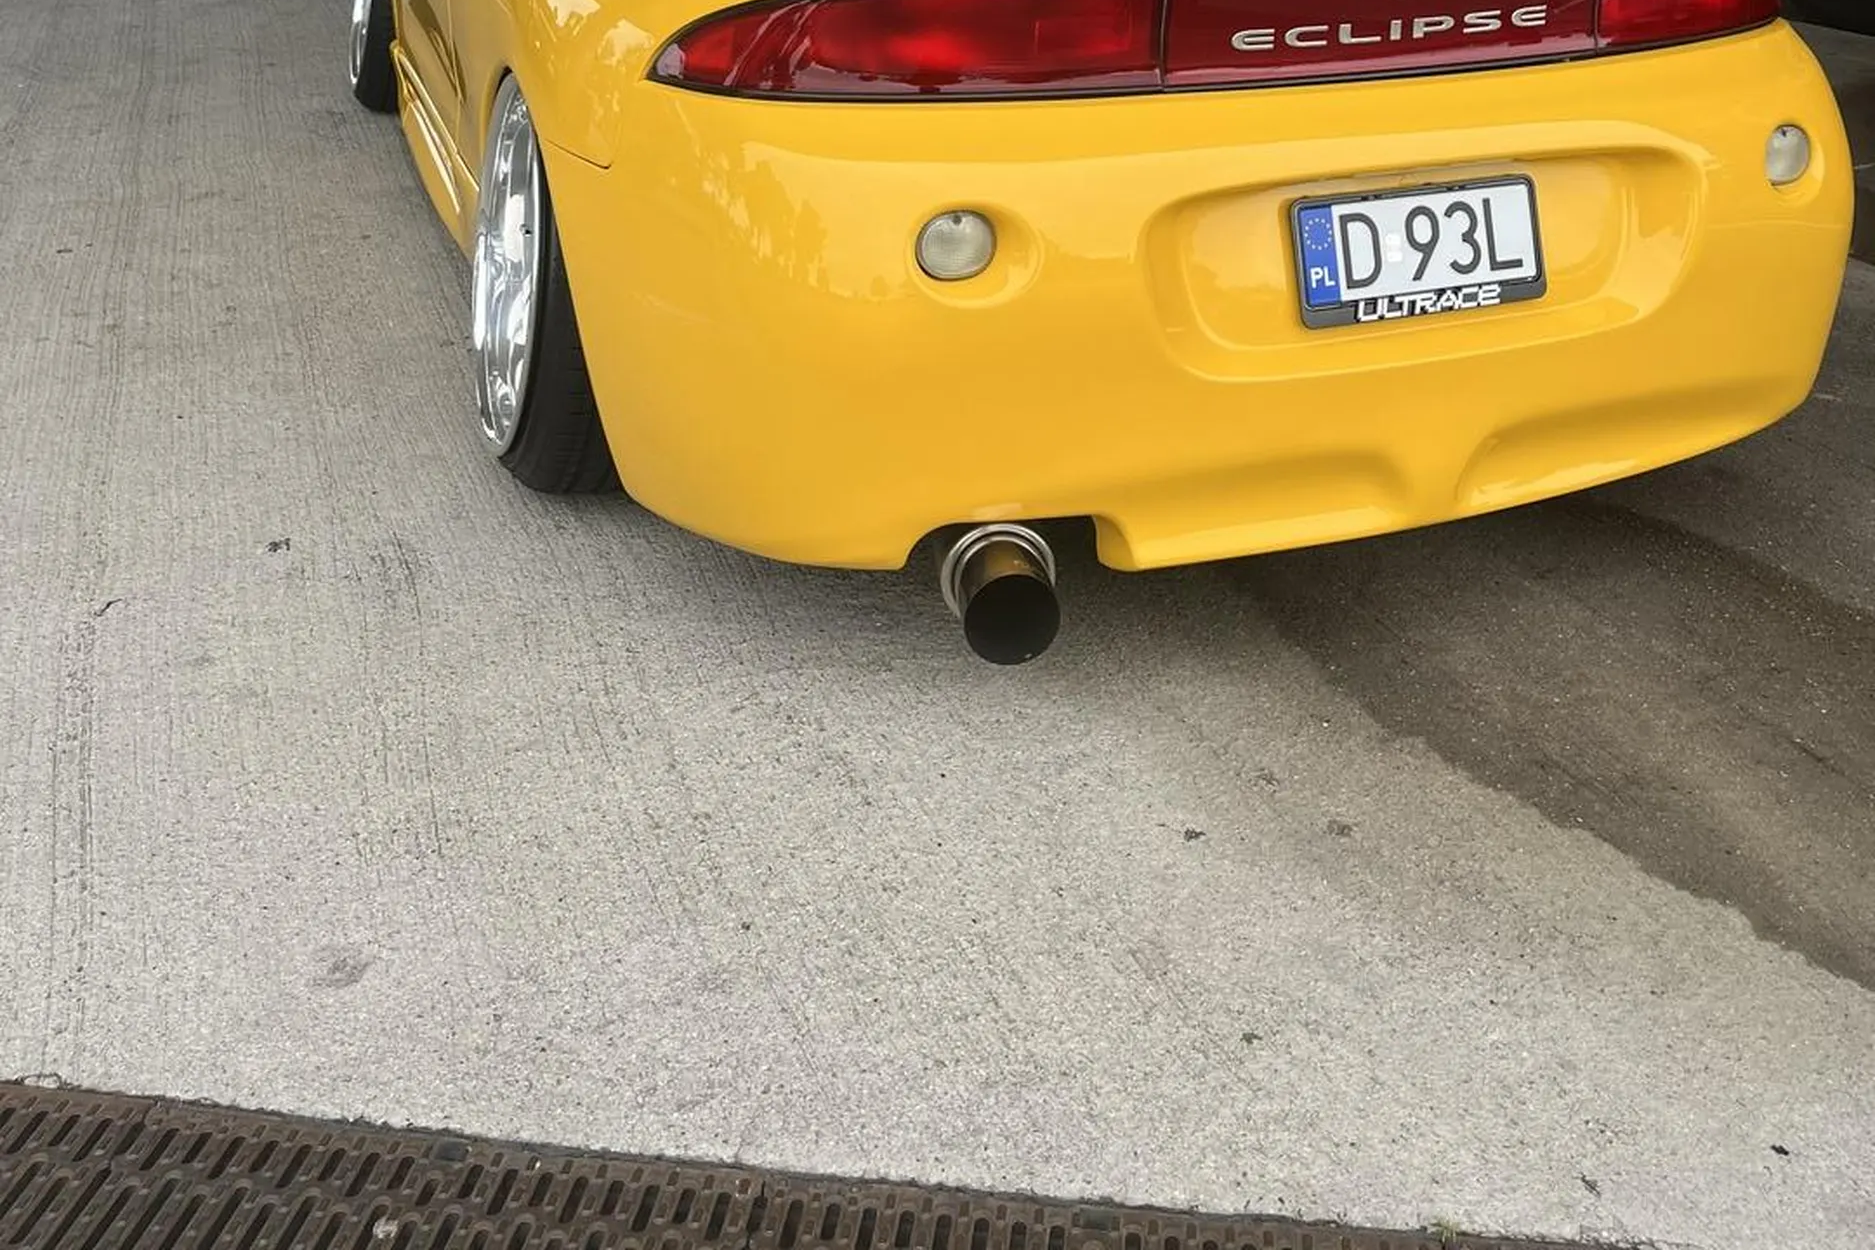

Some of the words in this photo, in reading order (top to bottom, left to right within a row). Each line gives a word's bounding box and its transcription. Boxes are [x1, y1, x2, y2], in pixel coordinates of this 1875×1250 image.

[1231, 4, 1547, 50] ECLIPSE
[1404, 197, 1524, 281] 93L
[1310, 267, 1336, 290] PL
[1355, 284, 1501, 323] ULTRACE
